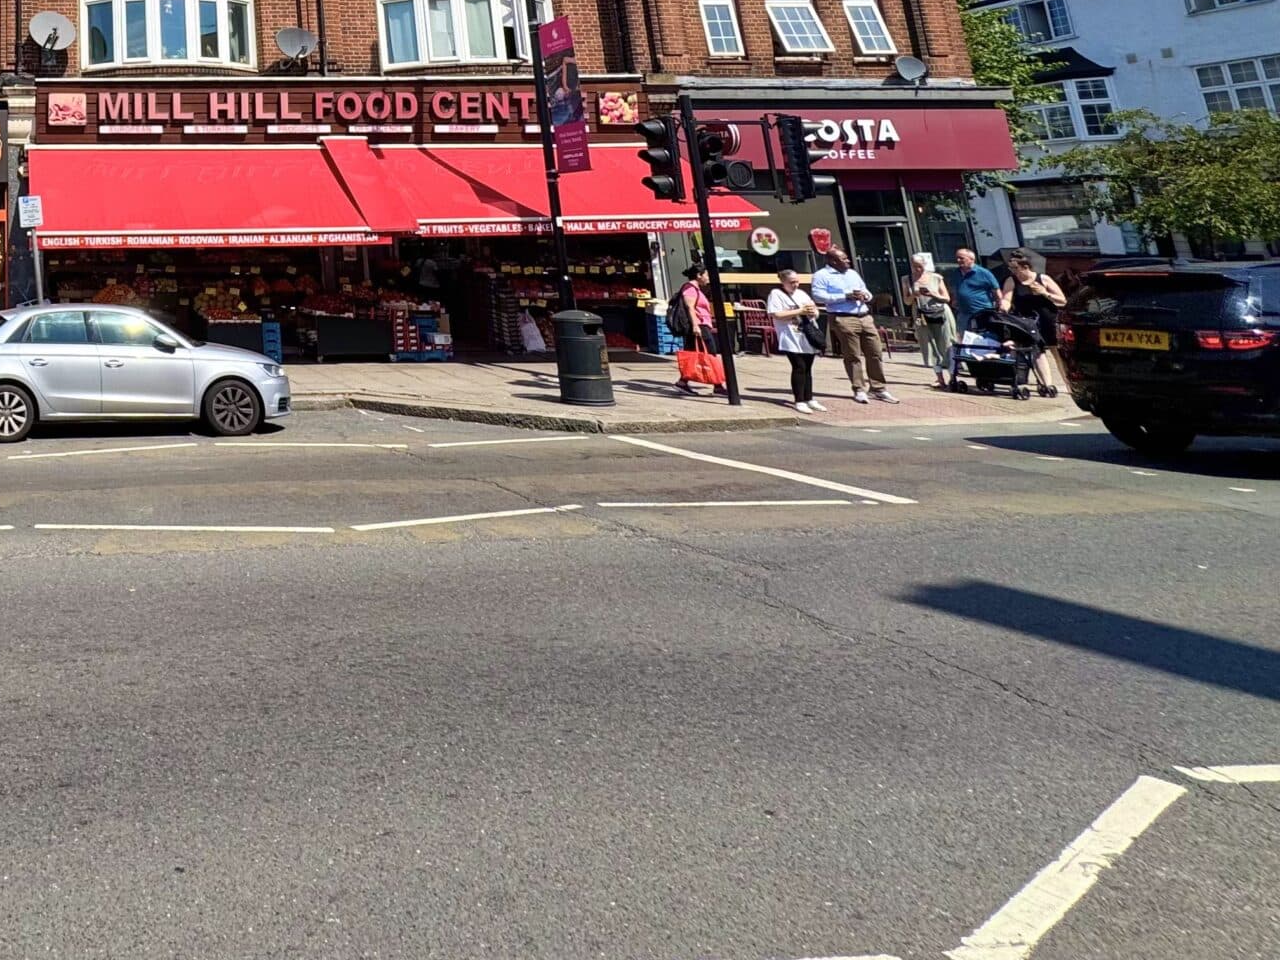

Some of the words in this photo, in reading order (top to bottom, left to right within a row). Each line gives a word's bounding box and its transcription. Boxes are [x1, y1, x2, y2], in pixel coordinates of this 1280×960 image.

[98, 92, 194, 119] MILL
[209, 92, 302, 119] HILL
[315, 91, 418, 120] FOOD
[431, 91, 590, 120] CENT
[431, 224, 464, 234] FRUITS
[468, 222, 524, 233] VEGETABLES
[567, 220, 594, 231] HALAL
[598, 220, 621, 230] MEAT
[626, 220, 668, 230] GROCERY
[715, 218, 740, 228] FOOD
[42, 237, 80, 246] ENGLISH
[84, 236, 122, 246] TURKISH
[127, 236, 174, 245] ROMANIAN
[228, 234, 265, 244] IRANIAN
[270, 234, 313, 243] ALBANIAN
